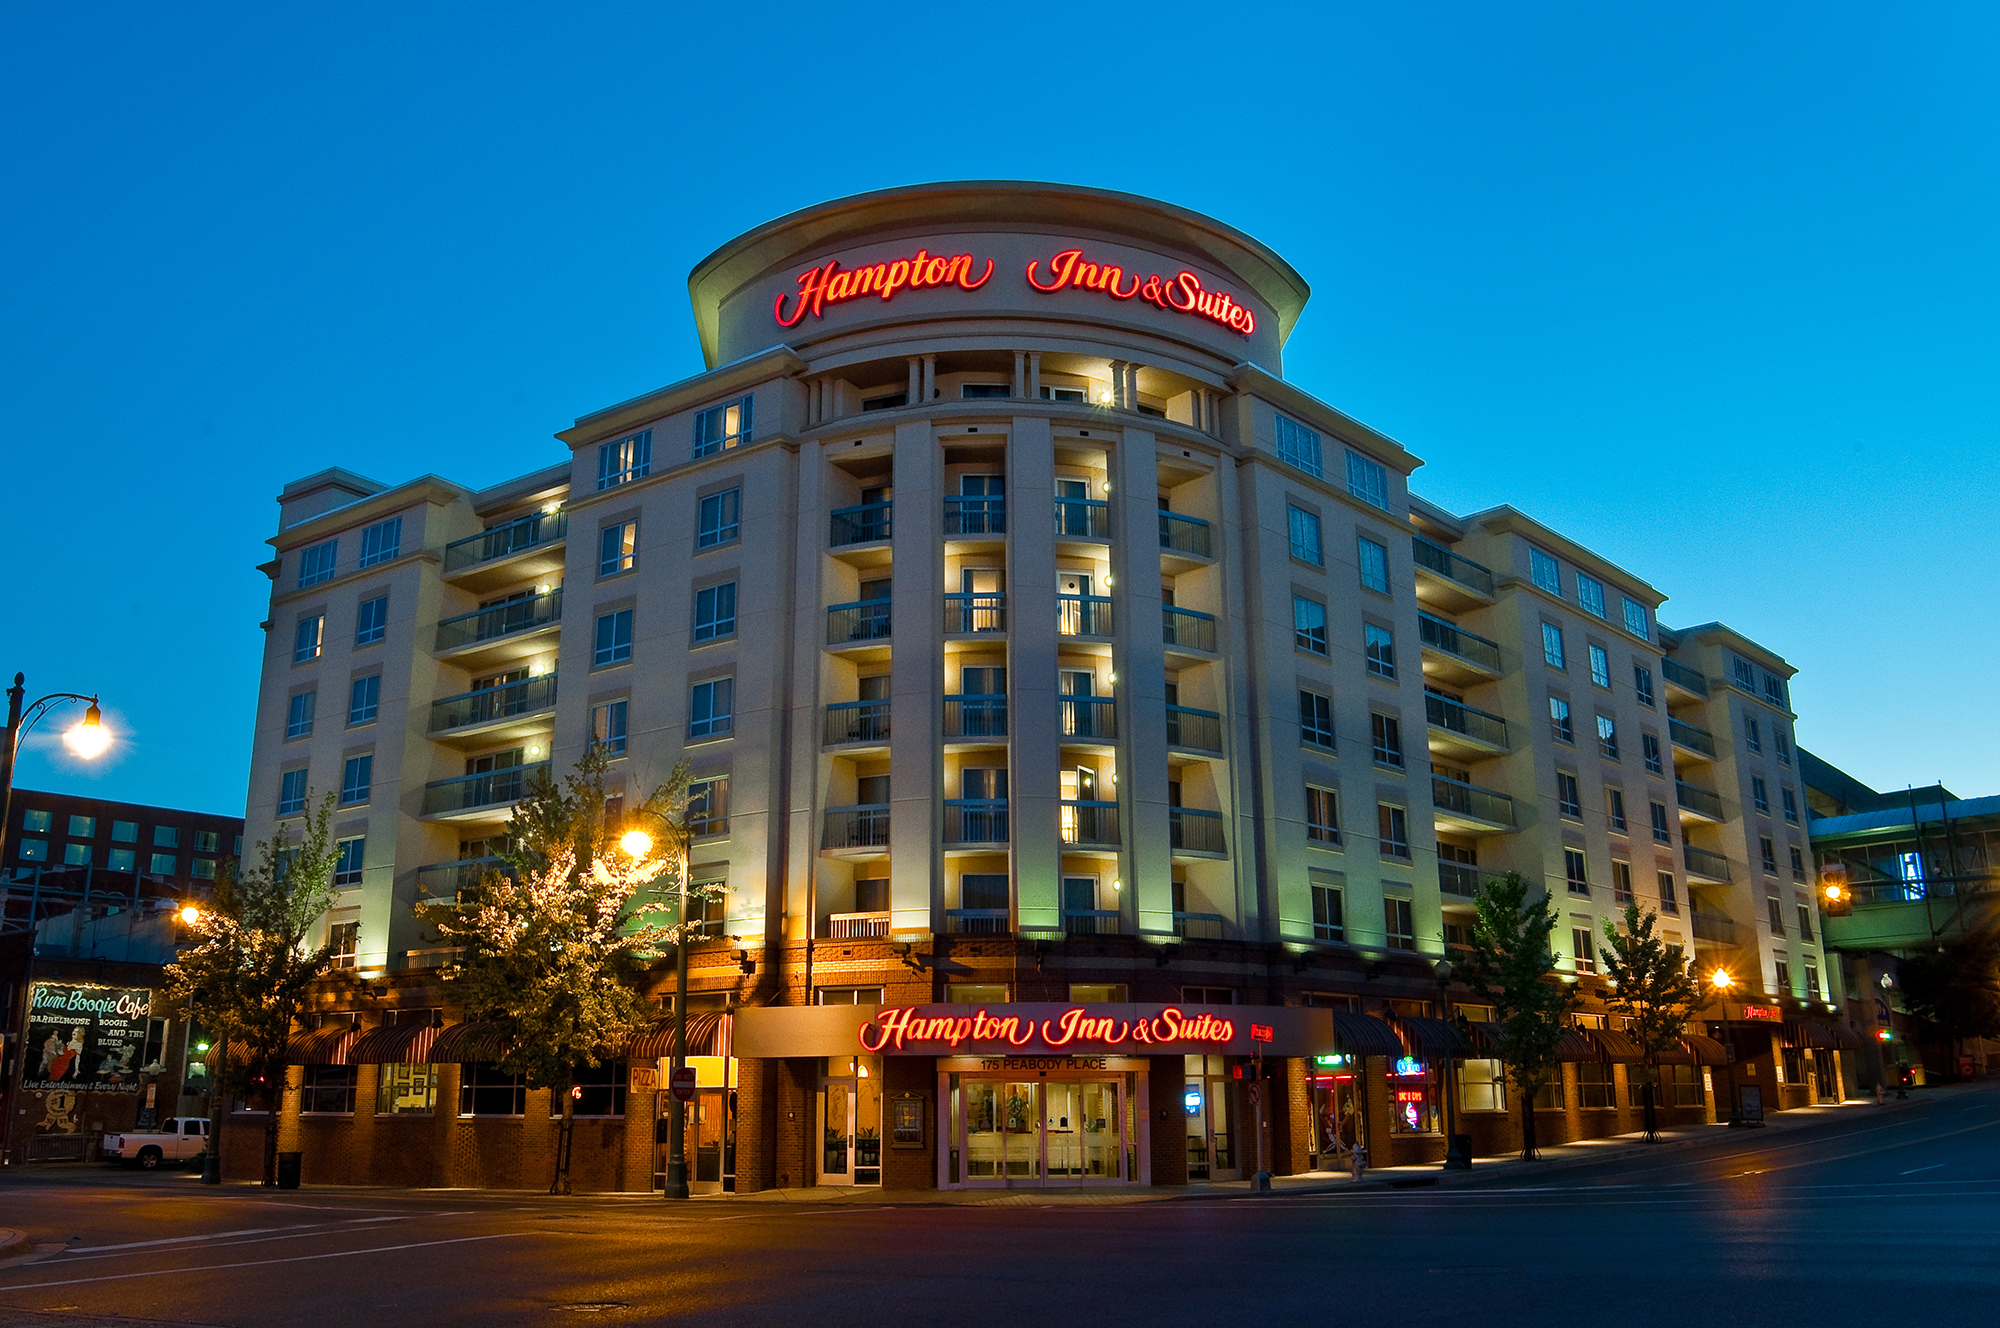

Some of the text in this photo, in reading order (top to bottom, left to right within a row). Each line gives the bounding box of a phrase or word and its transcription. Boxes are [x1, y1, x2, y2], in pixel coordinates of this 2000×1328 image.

[774, 249, 1256, 335] Hampton Inn & Suites
[32, 987, 149, 1021] Rum Boogie Cafe
[30, 1015, 90, 1025] BARRELHOUSE
[128, 1030, 145, 1038] THE
[858, 1005, 1035, 1052] Hampton
[1041, 1006, 1129, 1046] Inn
[1131, 1017, 1155, 1044] &
[1150, 1006, 1234, 1043] Suites
[97, 1038, 123, 1047] BLUES
[980, 1059, 1107, 1070] 175 PEABODY PLACE
[633, 1068, 656, 1086] PIZZA
[23, 1080, 39, 1089] Live
[94, 1082, 118, 1092] Every
